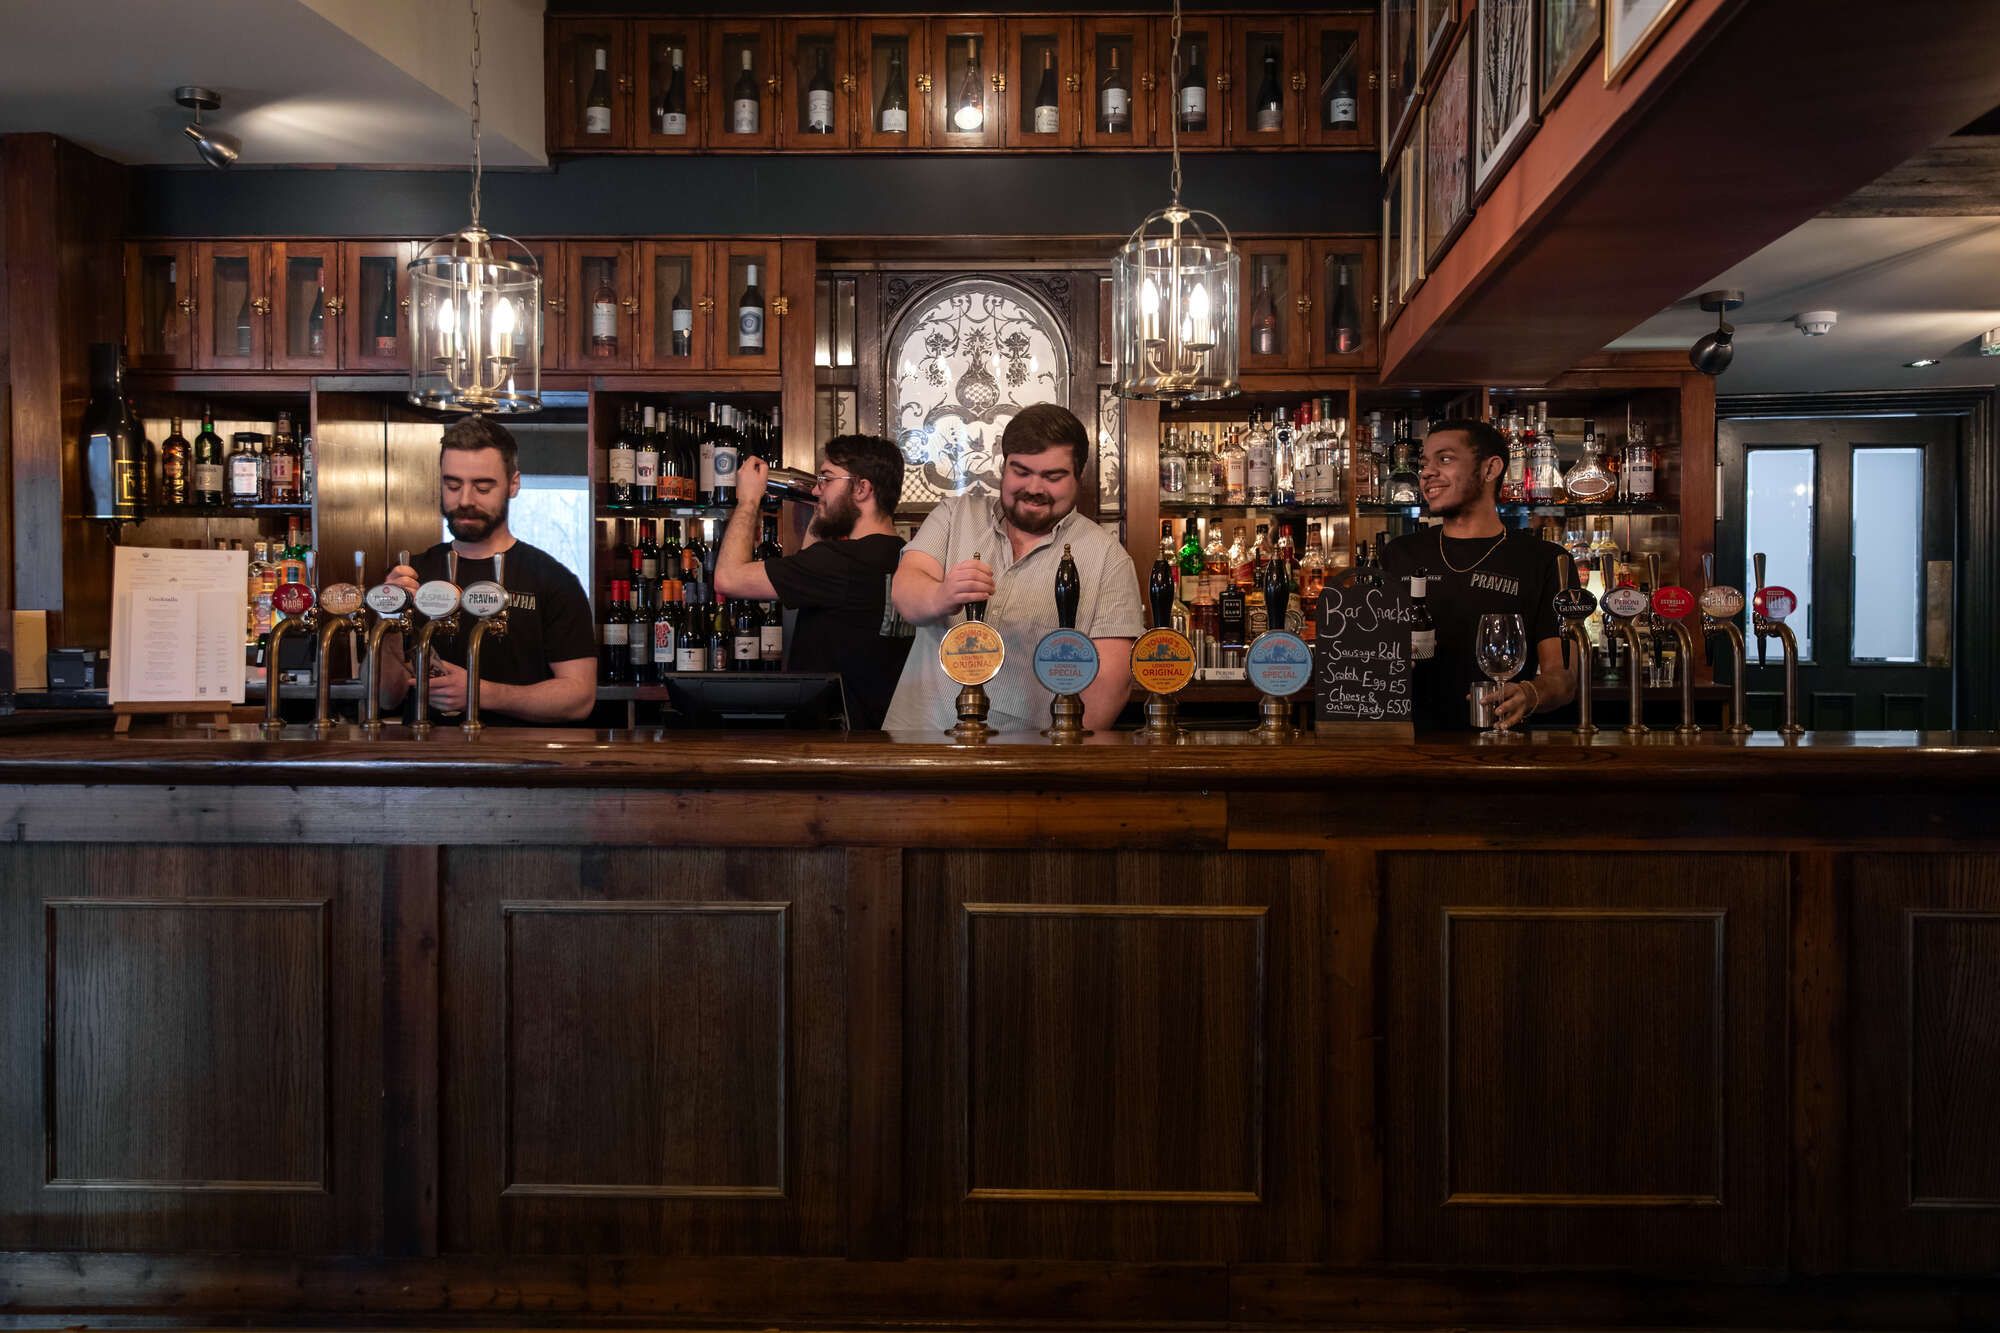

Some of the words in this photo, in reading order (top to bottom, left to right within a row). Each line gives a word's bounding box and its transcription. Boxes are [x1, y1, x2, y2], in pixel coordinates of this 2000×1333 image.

[1470, 573, 1520, 596] PRAVHA
[1320, 586, 1362, 638] Bar
[1356, 589, 1410, 632] Snacks
[1328, 640, 1377, 663] Sausage
[1379, 641, 1402, 659] Roll
[953, 660, 994, 669] ORIGINAL
[1048, 667, 1083, 677] SPECIAL
[1141, 668, 1185, 677] ORIGINAL
[1389, 659, 1406, 675] £5
[1323, 662, 1360, 684] Scotch
[1362, 671, 1387, 691] Egg
[1389, 679, 1407, 694] £5
[1329, 685, 1366, 703] Cheese
[1368, 691, 1377, 704] &
[1386, 699, 1411, 716] £5.50
